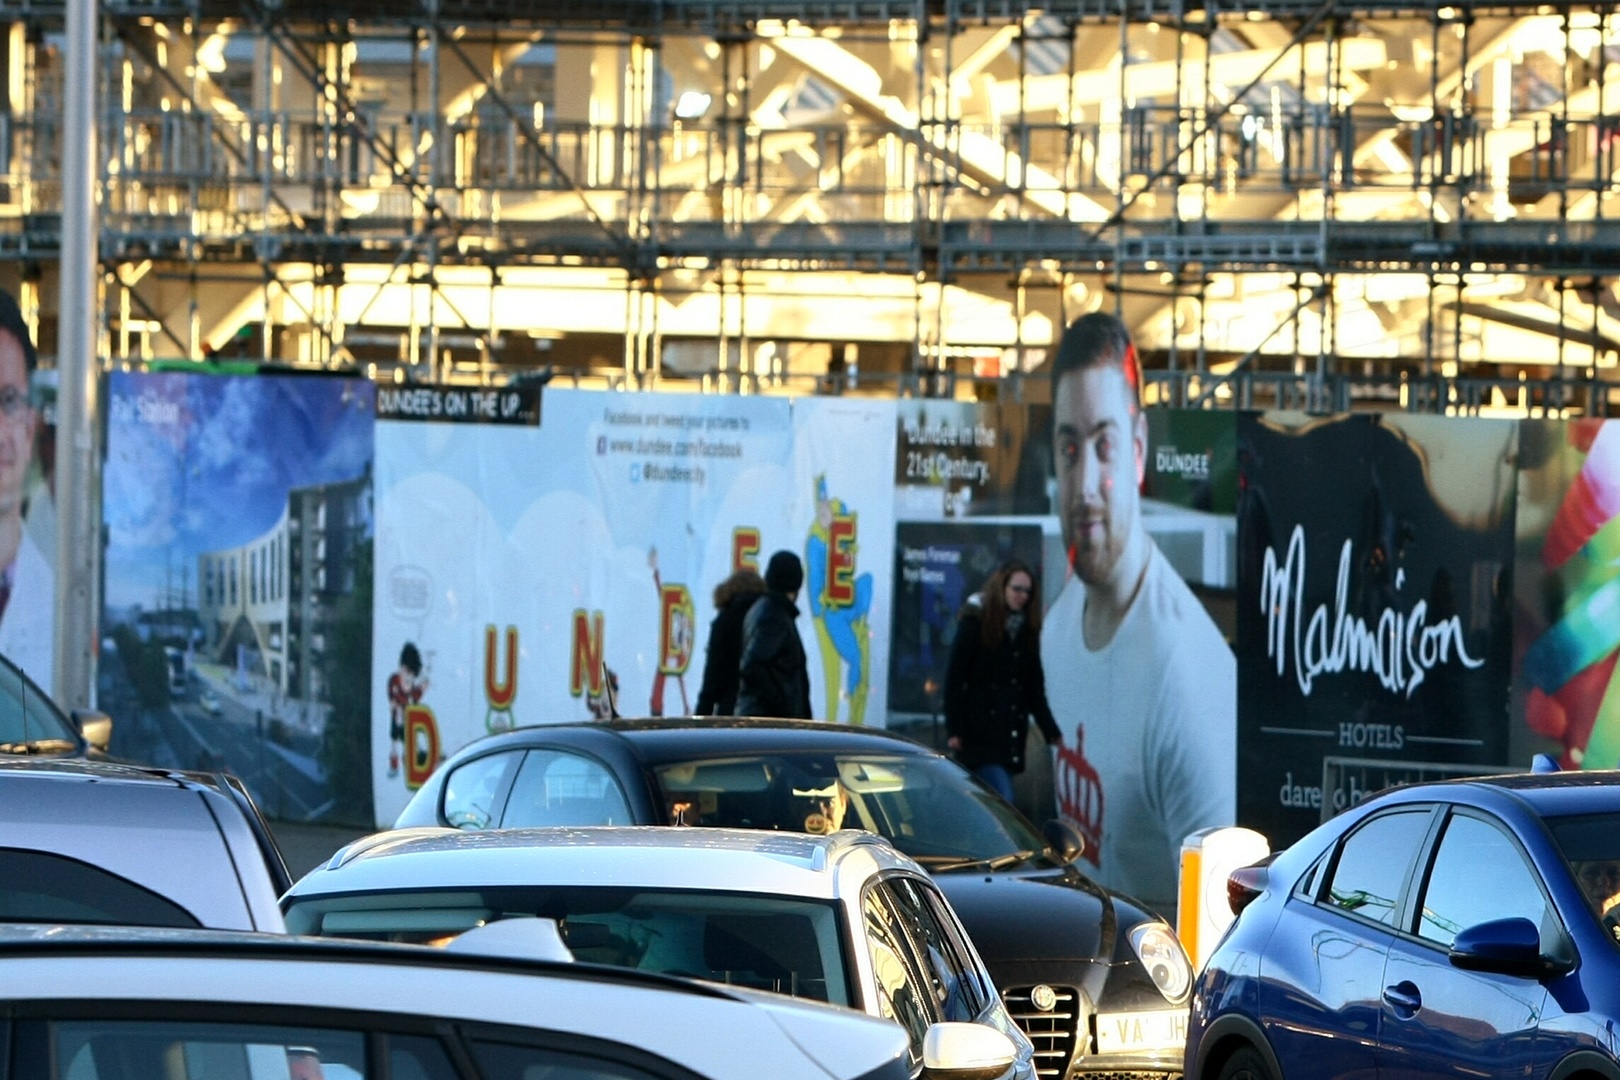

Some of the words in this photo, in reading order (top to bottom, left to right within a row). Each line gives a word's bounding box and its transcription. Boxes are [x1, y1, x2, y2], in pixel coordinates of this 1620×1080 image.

[445, 392, 467, 415] ON
[470, 391, 496, 417] THE
[959, 424, 972, 445] in
[973, 421, 997, 447] the
[906, 451, 933, 478] 21st
[1156, 452, 1208, 474] DUNDEE
[1260, 523, 1485, 700] Malmaison
[1339, 722, 1404, 750] HOTELS
[1280, 772, 1320, 809] dare
